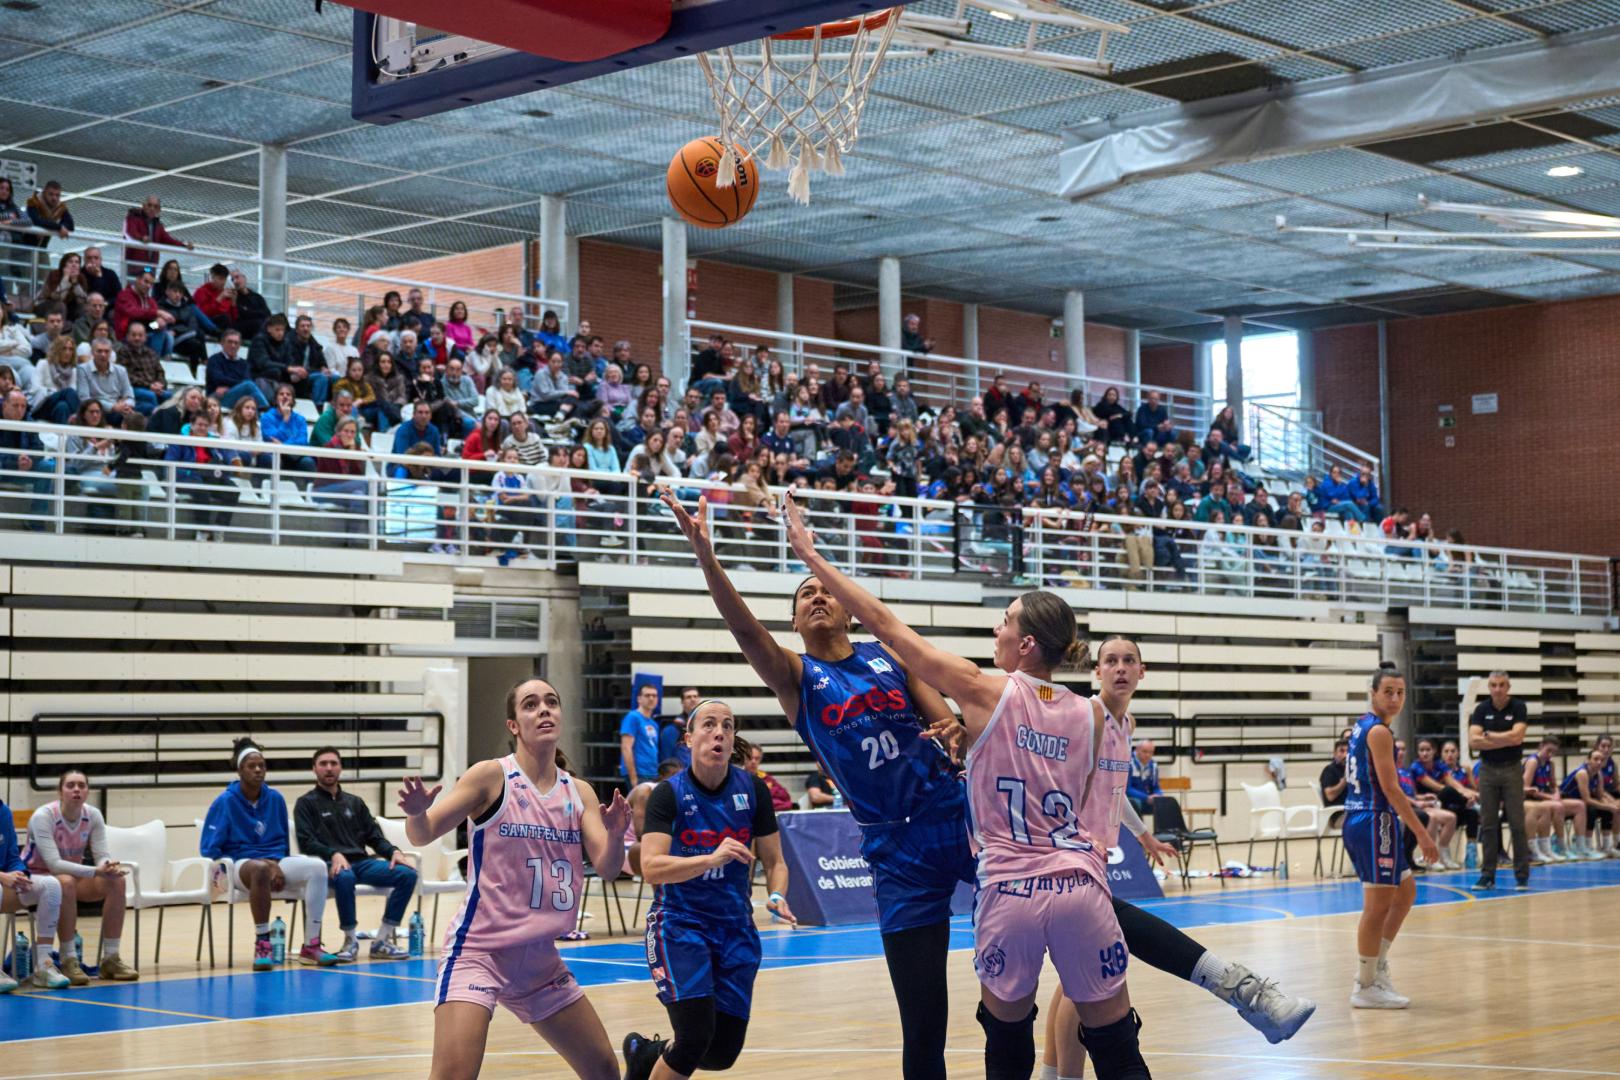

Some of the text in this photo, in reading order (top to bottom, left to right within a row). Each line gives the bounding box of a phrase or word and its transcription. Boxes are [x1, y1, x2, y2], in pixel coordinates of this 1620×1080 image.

[861, 730, 900, 771] 20
[1016, 724, 1070, 762] CONDE
[997, 776, 1094, 852] 12
[818, 855, 870, 871] Gobiern
[818, 874, 874, 890] de Navar
[526, 856, 576, 912] 13
